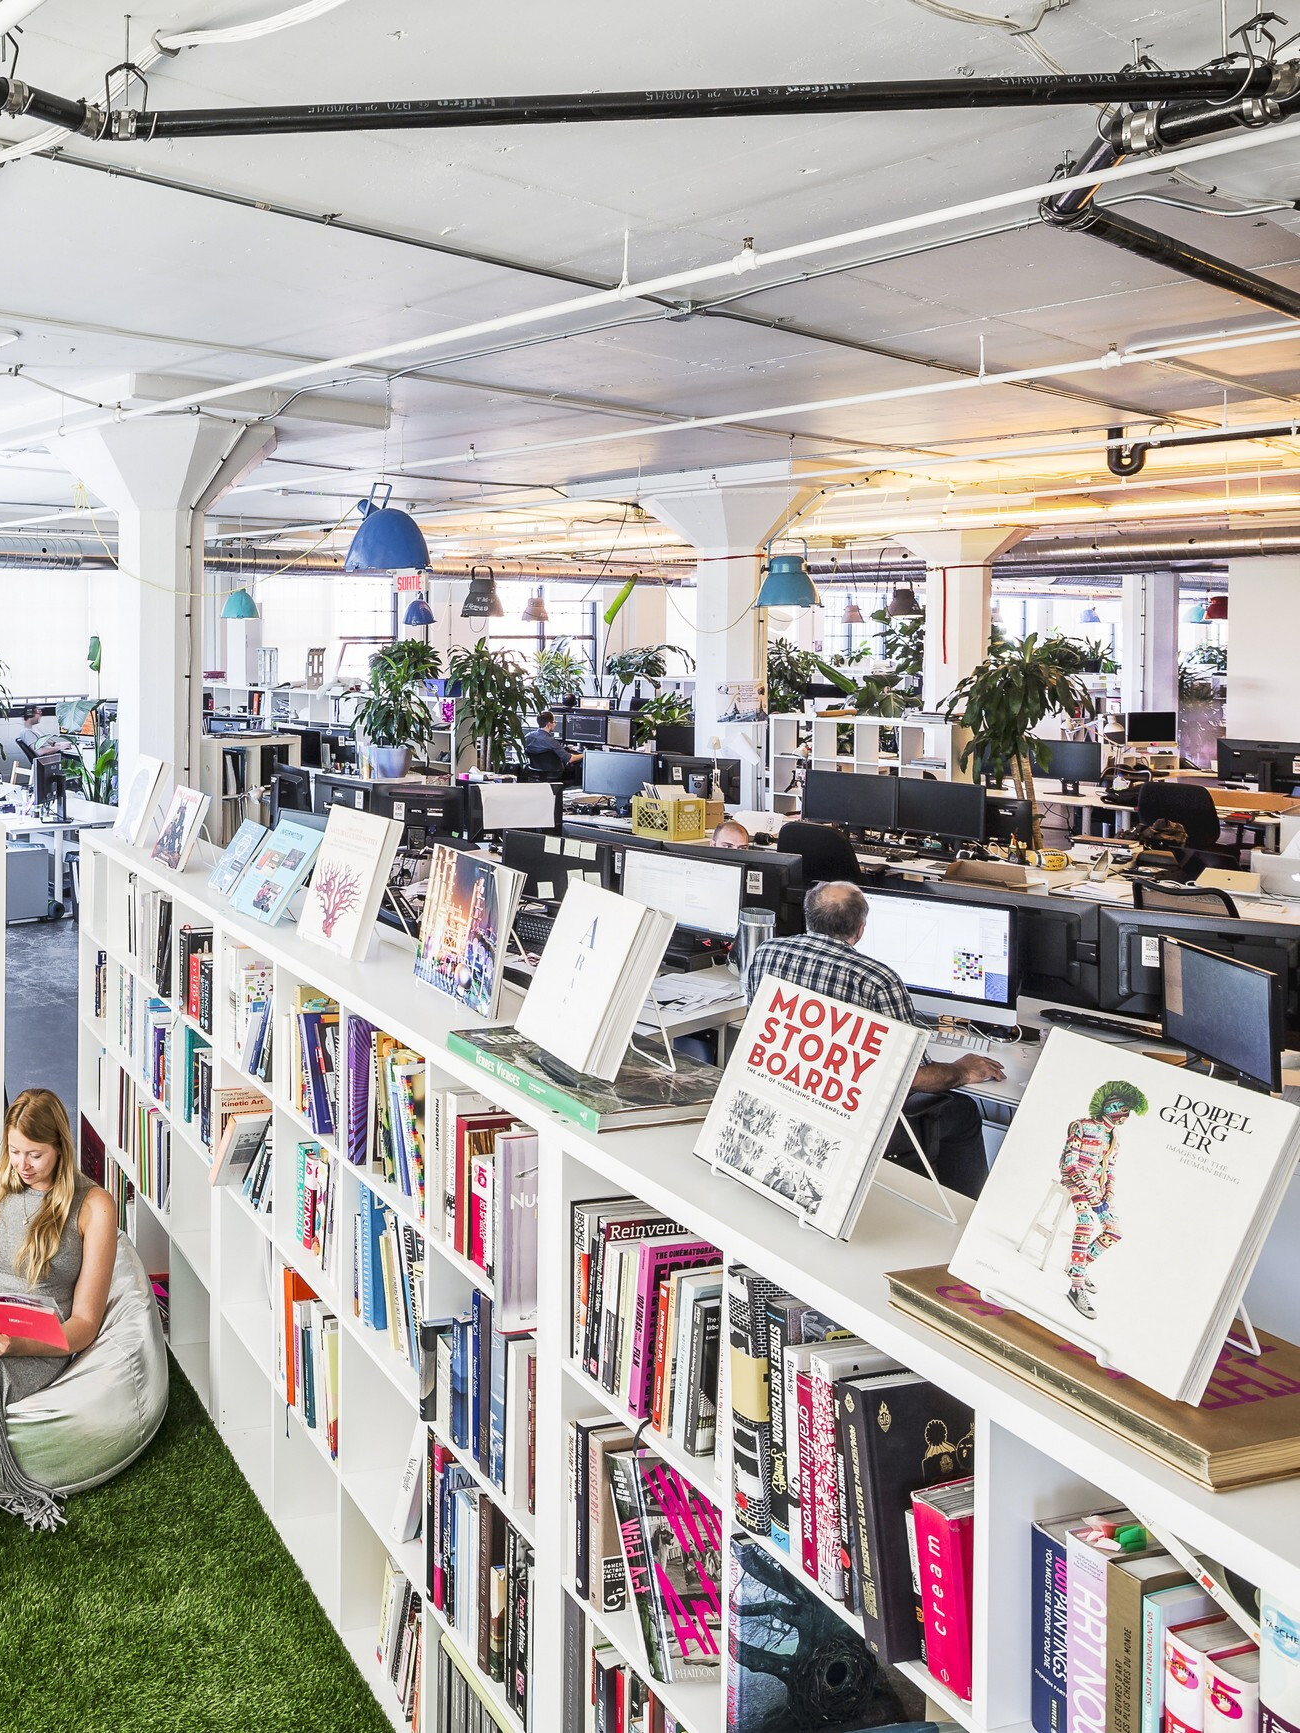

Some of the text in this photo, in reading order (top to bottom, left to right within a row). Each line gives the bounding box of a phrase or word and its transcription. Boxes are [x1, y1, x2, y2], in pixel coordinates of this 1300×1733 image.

[397, 575, 423, 591] SORTIE
[768, 986, 889, 1057] MOVIE
[475, 1050, 520, 1087] TERRES VIERGES
[759, 1017, 876, 1084] STORY
[746, 1066, 851, 1121] THE ART OF VISUALIZING SCREENPLAYS
[747, 1043, 862, 1112] BOARDS
[221, 1100, 249, 1108] Kinetic
[1159, 1106, 1229, 1142] GANG
[1165, 1143, 1229, 1173] IMAGES OF THE
[1182, 1130, 1213, 1155] ER
[1179, 1156, 1241, 1186] HUMAN BEING
[404, 1227, 415, 1285] WILLIAM
[655, 1251, 667, 1260] THE
[635, 1309, 644, 1333] IDEAS
[633, 1347, 641, 1369] FILM
[769, 1323, 782, 1370] STREET
[787, 1359, 795, 1396] Banksy
[771, 1370, 784, 1447] SKETCHBOOK
[589, 1447, 599, 1524] POSTSECRET
[798, 1405, 815, 1543] graffiti NEW YORK
[836, 1452, 849, 1544] PAVEMENT CHALK ARTIST
[603, 1567, 626, 1575] FACTORY
[620, 1517, 651, 1595] Wild Art
[1045, 1548, 1053, 1563] YOU
[927, 1535, 947, 1636] cream
[1053, 1556, 1067, 1683] 1001 PAINTINGS
[1073, 1582, 1107, 1669] ART
[1043, 1637, 1051, 1654] YOU
[1124, 1627, 1132, 1656] MONDE
[674, 1667, 715, 1679] PHAIDON
[1035, 1668, 1053, 1690] STEPHEN
[1123, 1669, 1131, 1701] CHÈRES
[1114, 1658, 1123, 1733] LES ŒUVRES D'ART
[1123, 1702, 1131, 1720] PLUS
